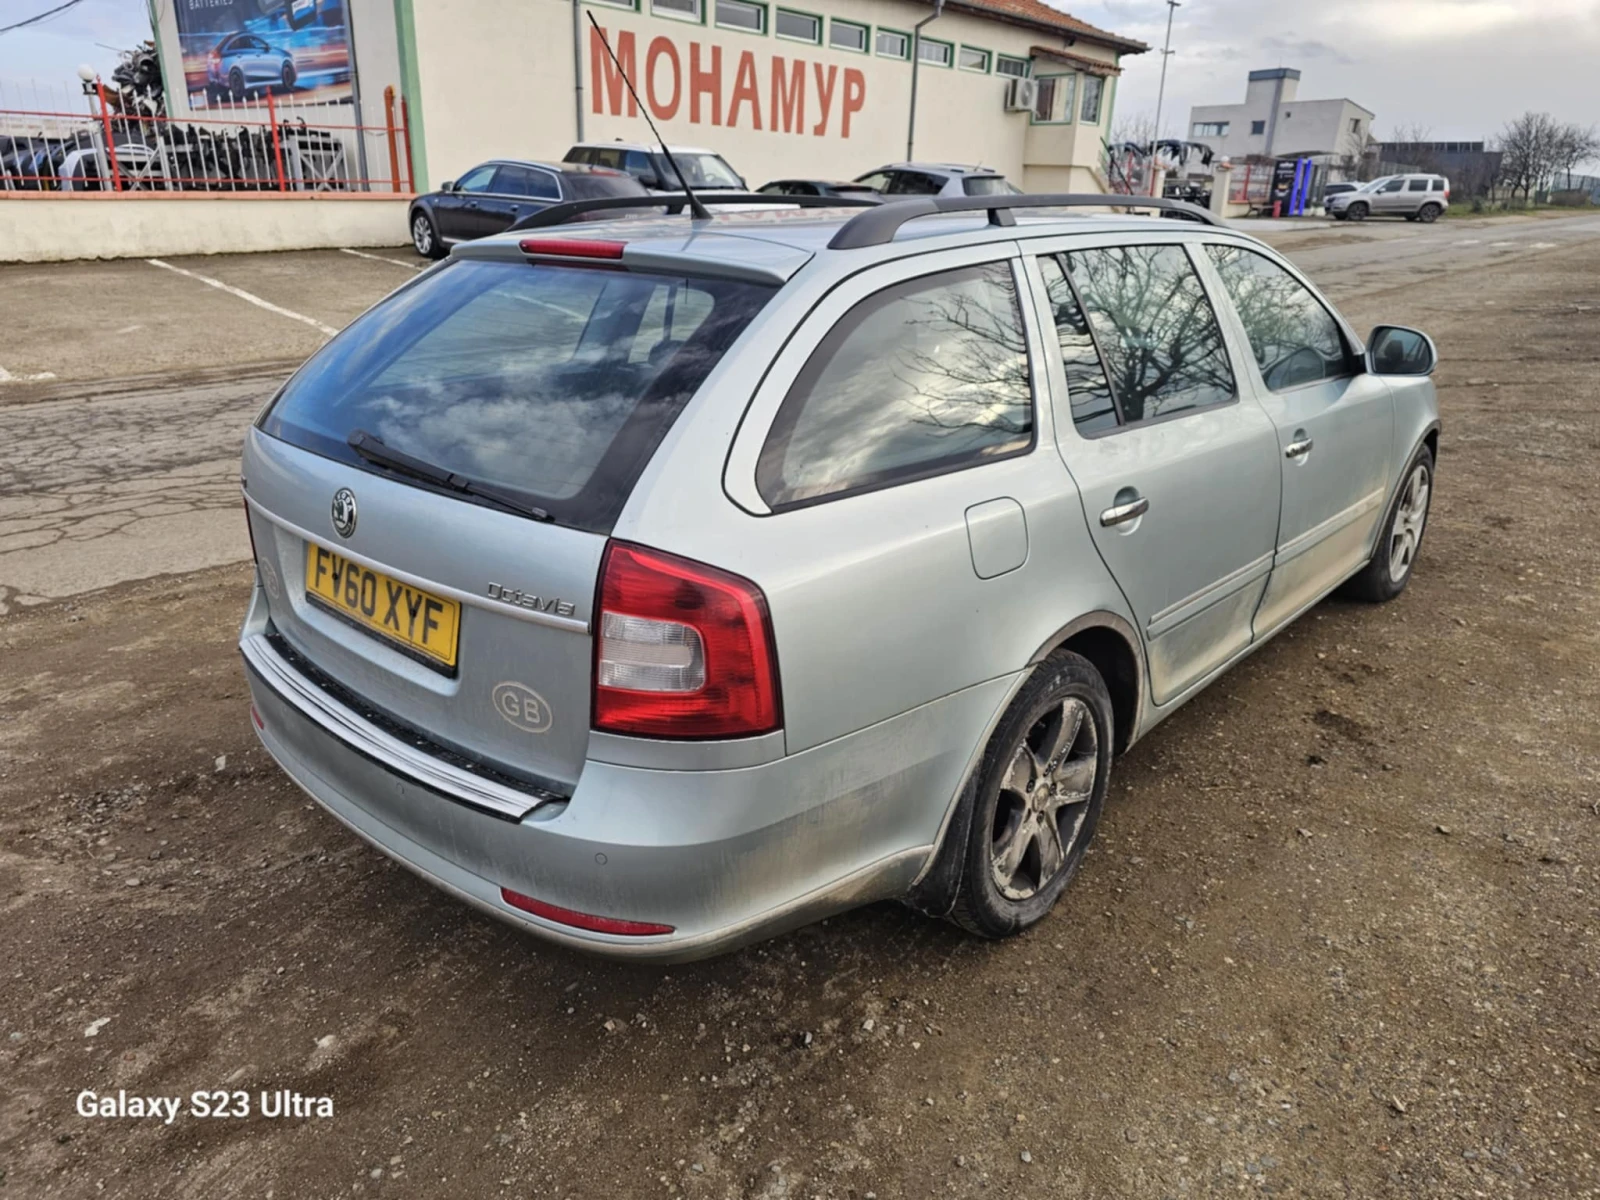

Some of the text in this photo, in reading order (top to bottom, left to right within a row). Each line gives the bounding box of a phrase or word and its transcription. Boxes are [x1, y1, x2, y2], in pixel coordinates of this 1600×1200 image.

[590, 25, 866, 139] МОНАМУР
[315, 547, 444, 645] FV60 XYF
[488, 582, 576, 617] Octavia
[502, 691, 541, 724] GB
